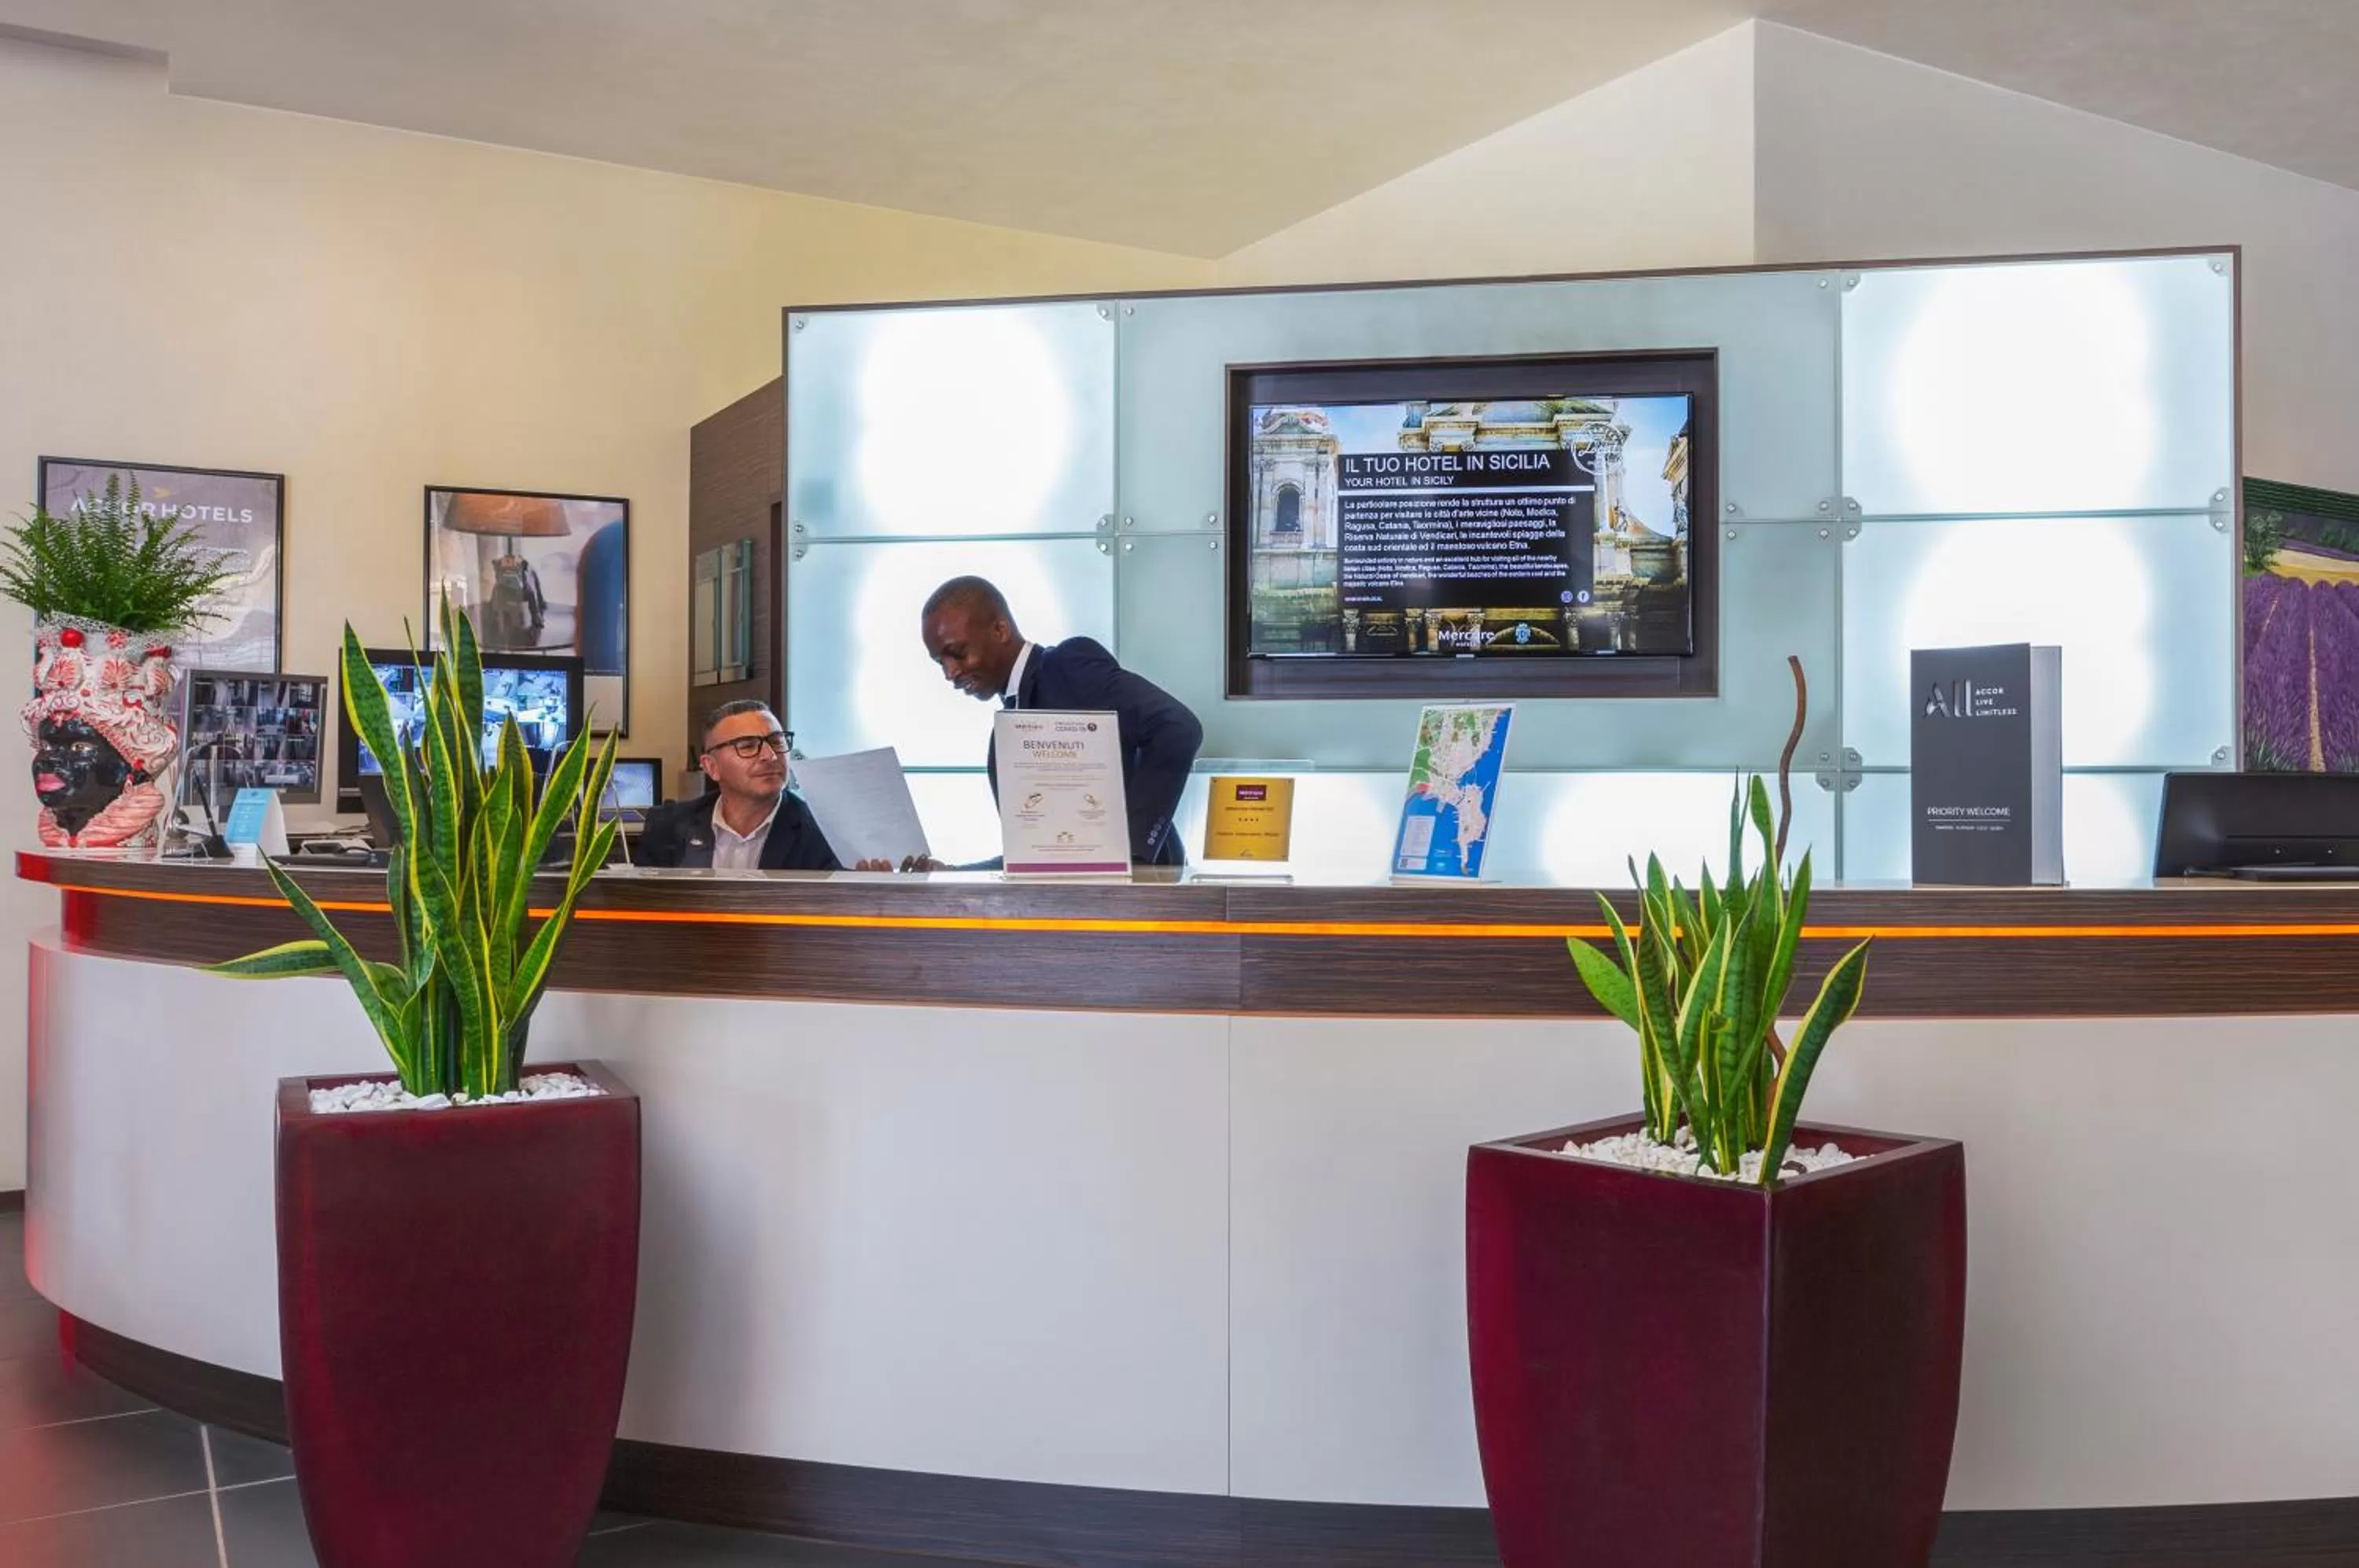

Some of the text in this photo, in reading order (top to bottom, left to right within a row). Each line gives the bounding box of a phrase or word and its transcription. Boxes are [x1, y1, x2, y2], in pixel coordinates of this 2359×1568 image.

[1345, 454, 1551, 473] IL TUO HOTEL IN SICILIA
[1344, 476, 1454, 487] YOUR HOTEL IN SICILY
[71, 497, 156, 517] AOR
[1345, 500, 1355, 509] La
[1544, 497, 1566, 506] punto
[1568, 496, 1576, 505] di
[1380, 512, 1393, 521] per
[1438, 630, 1495, 641] Mercre
[1023, 740, 1084, 750] BENVENUTI
[1927, 807, 2011, 816] PRIORITY WELCOME
